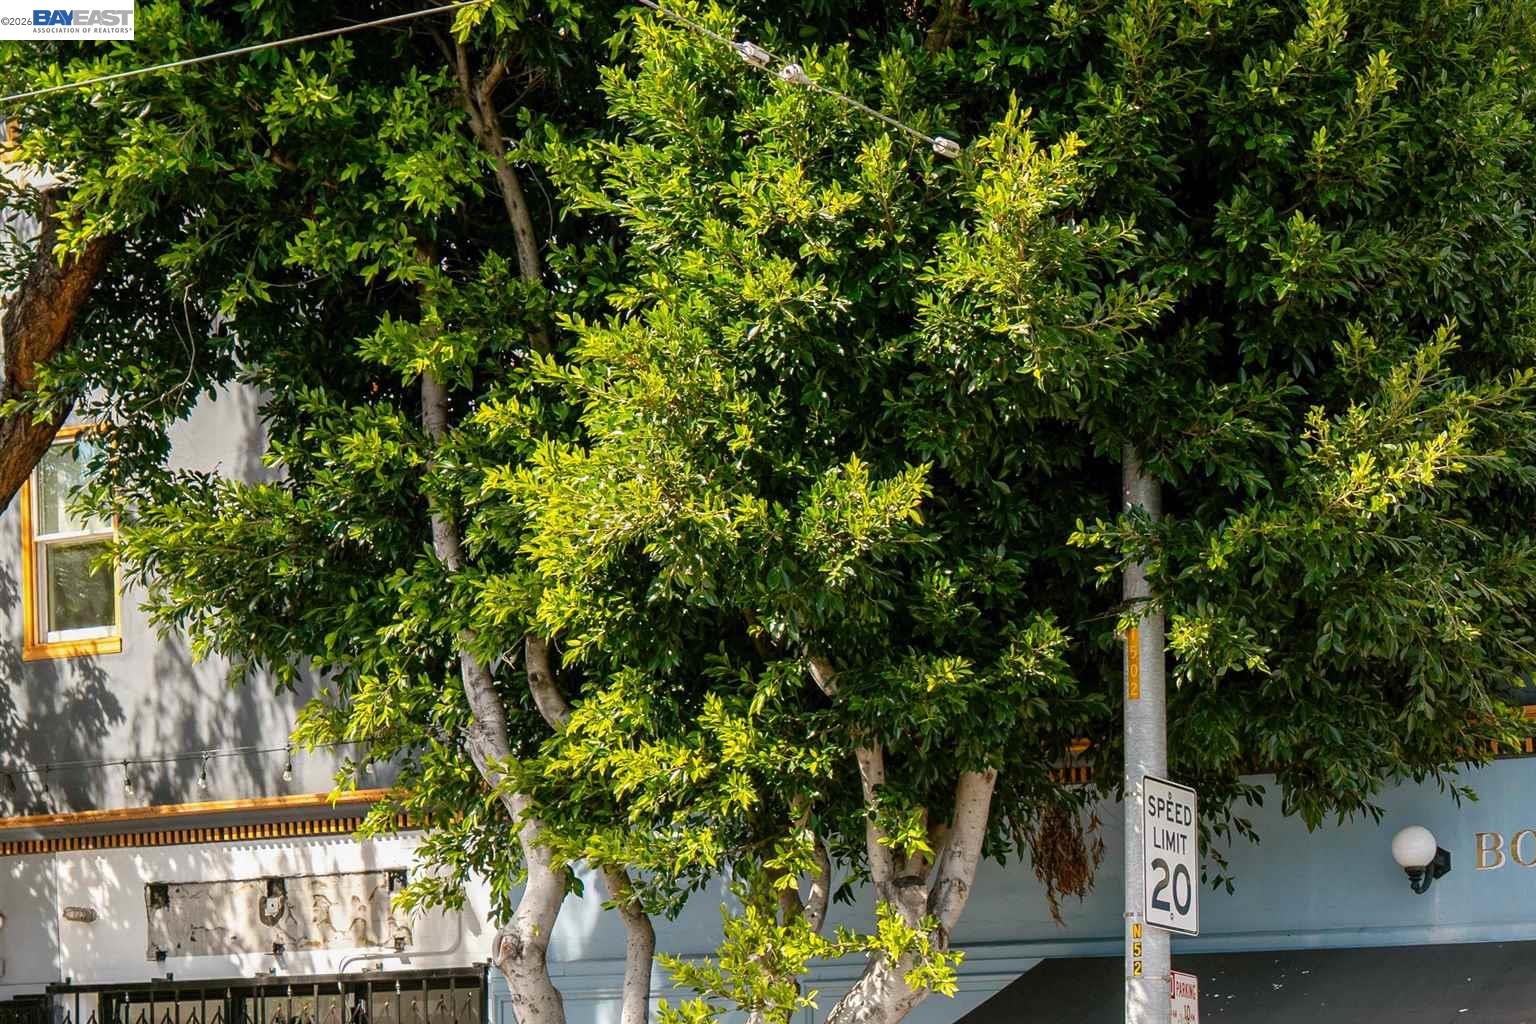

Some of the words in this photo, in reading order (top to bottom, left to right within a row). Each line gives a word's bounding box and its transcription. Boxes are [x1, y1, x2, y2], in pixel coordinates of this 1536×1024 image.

[1148, 795, 1192, 827] SPEED
[1153, 827, 1187, 855] LIMIT
[1151, 858, 1192, 916] 20
